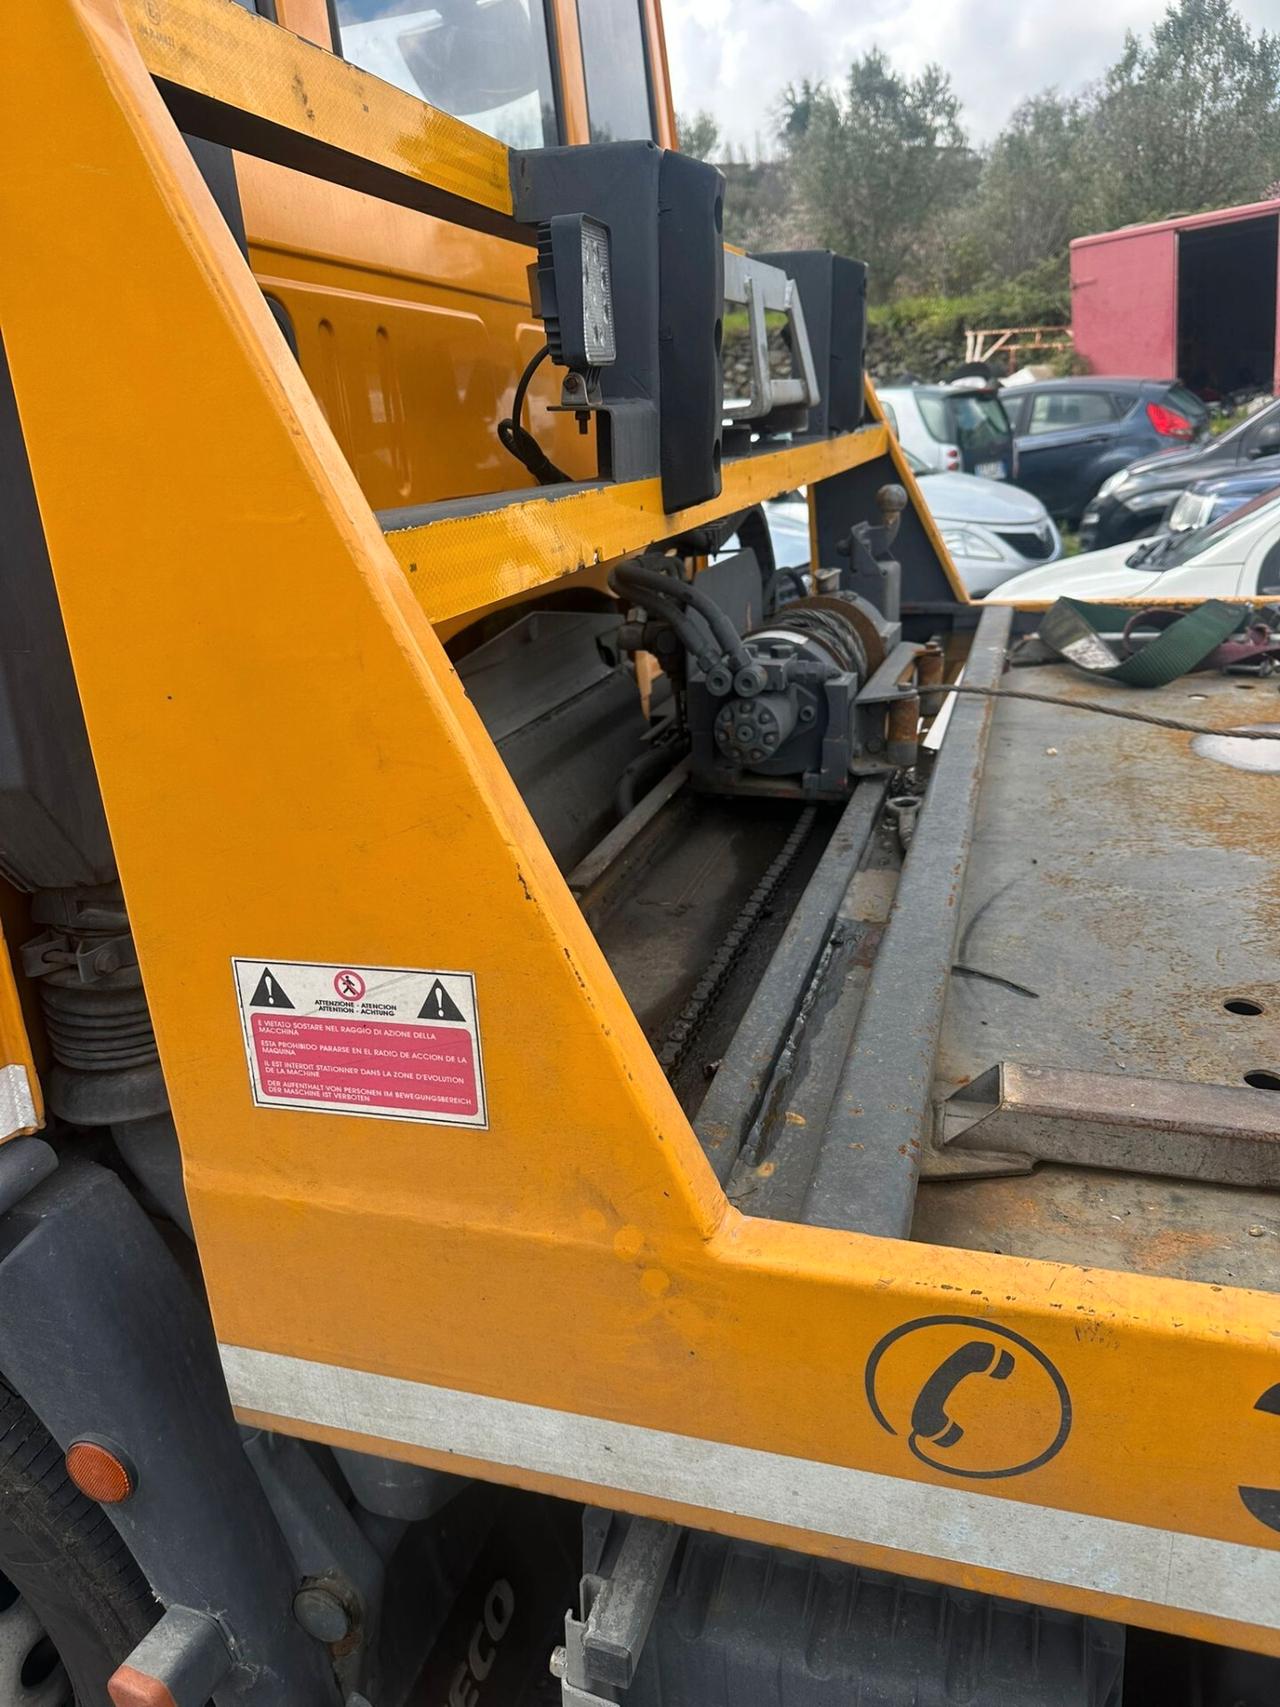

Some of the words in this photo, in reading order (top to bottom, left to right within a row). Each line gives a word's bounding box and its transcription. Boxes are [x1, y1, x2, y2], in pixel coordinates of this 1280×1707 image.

[259, 1027, 299, 1036] MACCHINA
[384, 1030, 410, 1038] AZIONE
[413, 1032, 436, 1040] DELLA
[278, 1041, 317, 1050] PROHIBIDO
[412, 1052, 443, 1061] ACCION
[316, 1065, 358, 1073] STATIONNER
[416, 1073, 464, 1084] D'EVOLUTION
[283, 1081, 323, 1090] AUFENTHALT
[344, 1087, 382, 1096] PERSONEN
[395, 1092, 471, 1104] BEWEGUNGSBEREICH
[284, 1088, 320, 1097] MASCHINE
[334, 1093, 370, 1102] VERBOTEN
[444, 1578, 515, 1707] ECO
